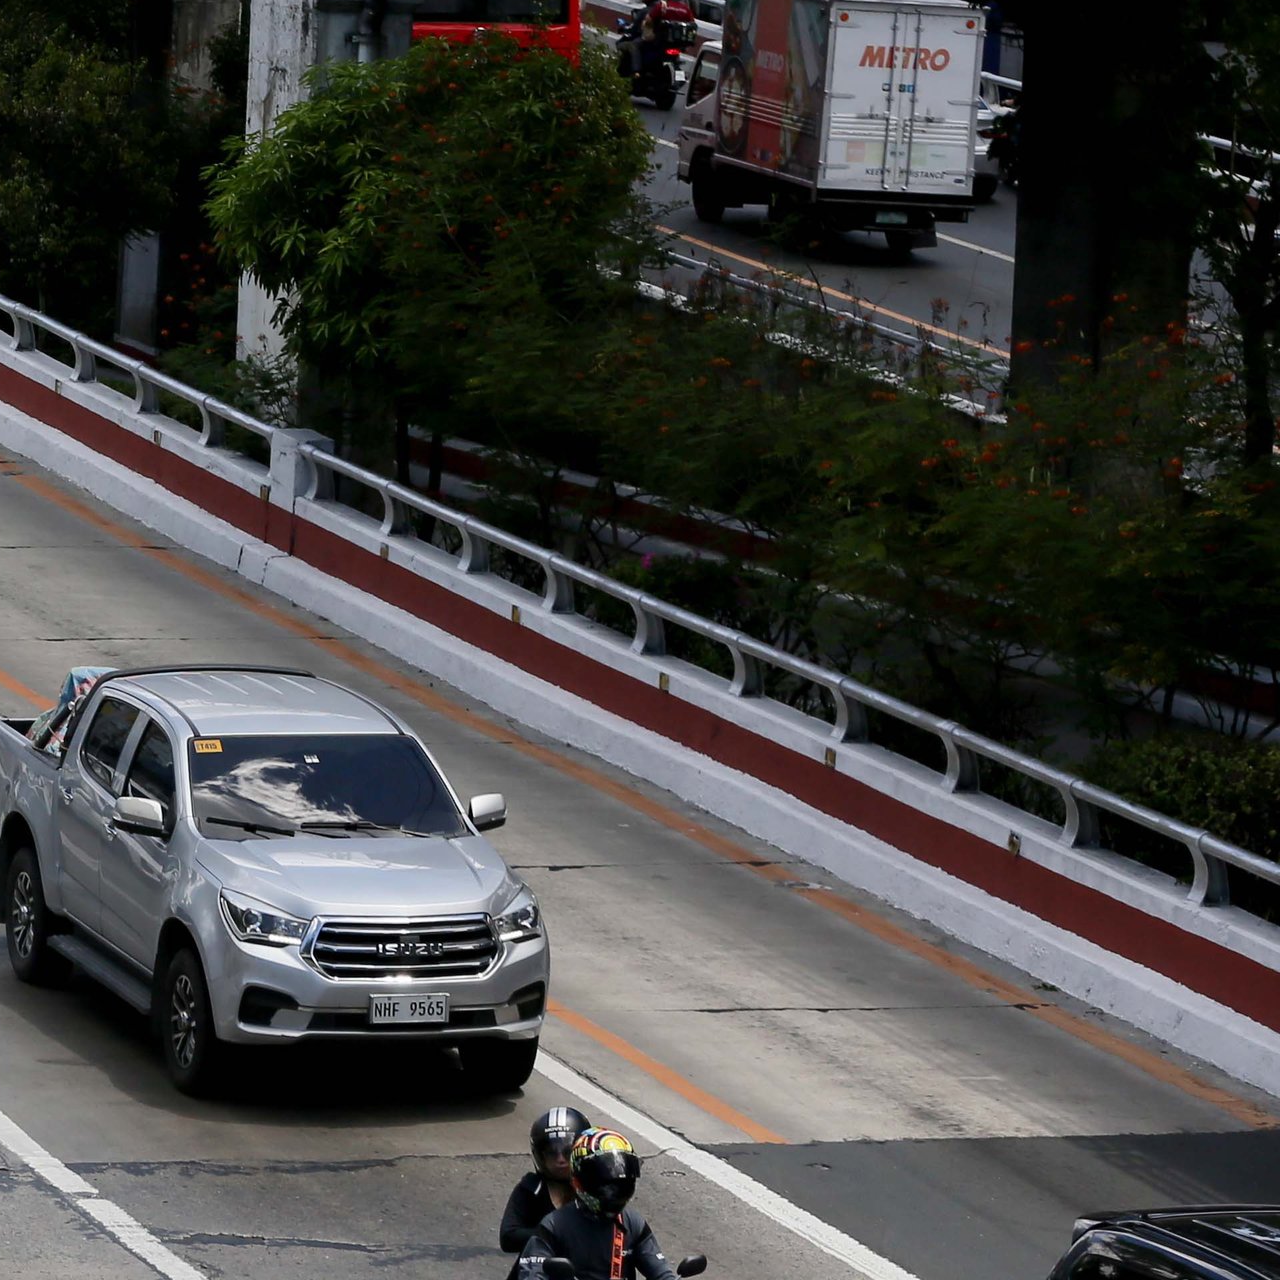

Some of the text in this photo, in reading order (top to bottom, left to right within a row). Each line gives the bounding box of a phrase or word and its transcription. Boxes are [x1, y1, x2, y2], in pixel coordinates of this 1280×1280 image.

[858, 45, 951, 72] METRO
[378, 942, 443, 956] ISUZU
[374, 1000, 444, 1018] NHF 9565
